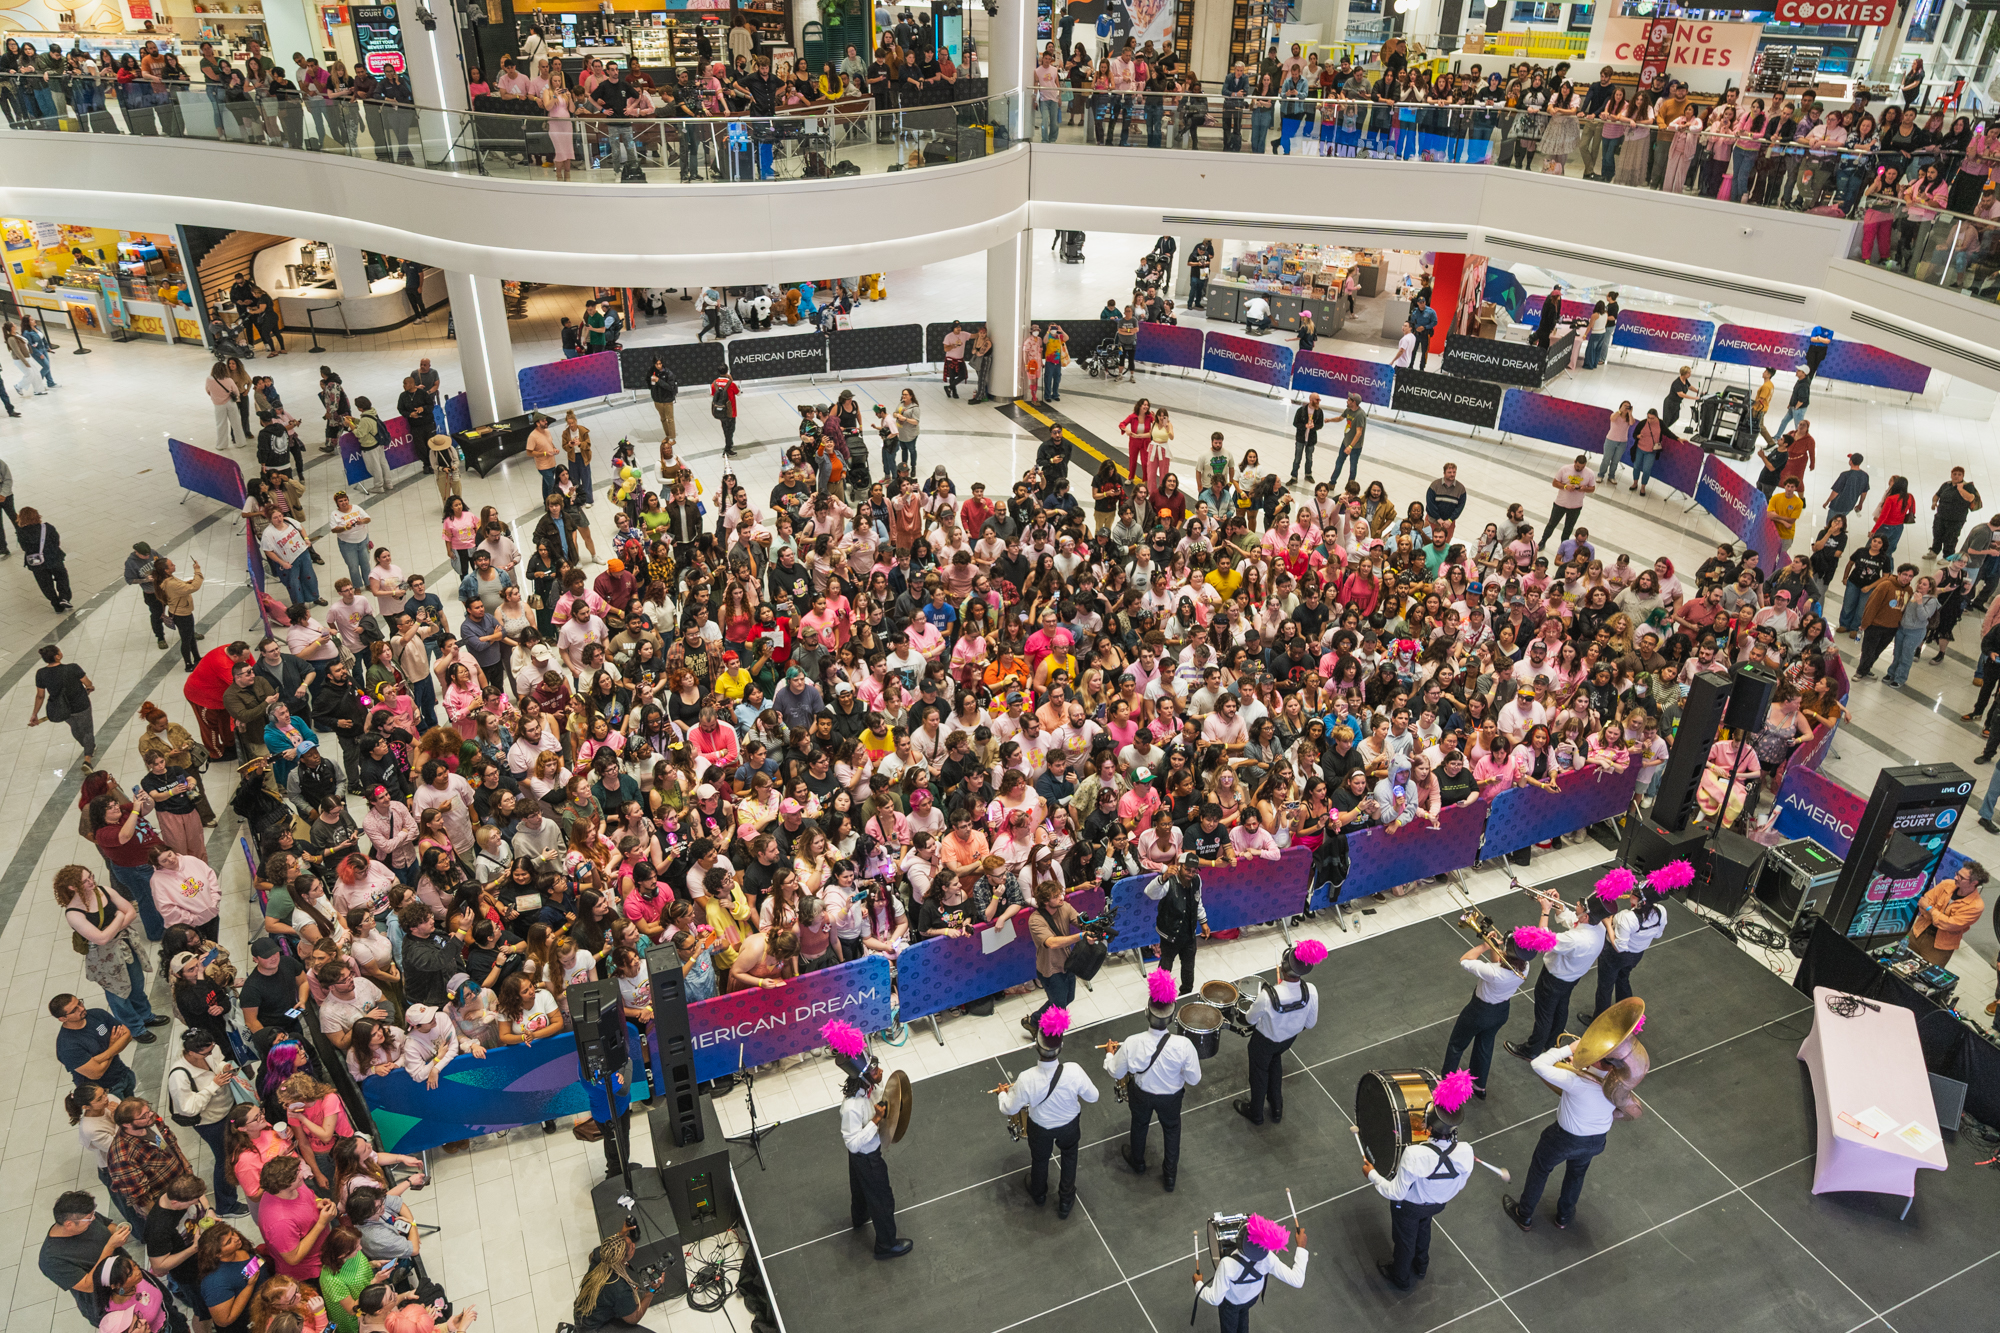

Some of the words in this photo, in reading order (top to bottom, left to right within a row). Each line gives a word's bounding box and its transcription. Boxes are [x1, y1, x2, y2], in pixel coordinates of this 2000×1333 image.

[1782, 2, 1887, 22] COOKIES
[1641, 23, 1713, 43] BNG
[1618, 323, 1668, 338] AMERICAN
[1672, 331, 1706, 343] DREAM
[1718, 338, 1771, 353] AMERICAN
[733, 352, 784, 364] AMERICAN
[787, 349, 822, 359] DREAM
[1207, 346, 1252, 363] AMERICAN
[1255, 357, 1286, 371] DREAM
[1448, 349, 1500, 365] AMERICAN
[1502, 358, 1539, 371] DREAM
[1297, 366, 1348, 382] AMERICAN
[1351, 374, 1387, 389] DREAM
[1398, 384, 1451, 401] AMERICAN
[1454, 394, 1493, 409] DREAM
[1702, 474, 1733, 504] AMERICAN
[1732, 497, 1757, 523] DREAM
[1892, 817, 1934, 828] COURT
[795, 987, 876, 1022] DREAM
